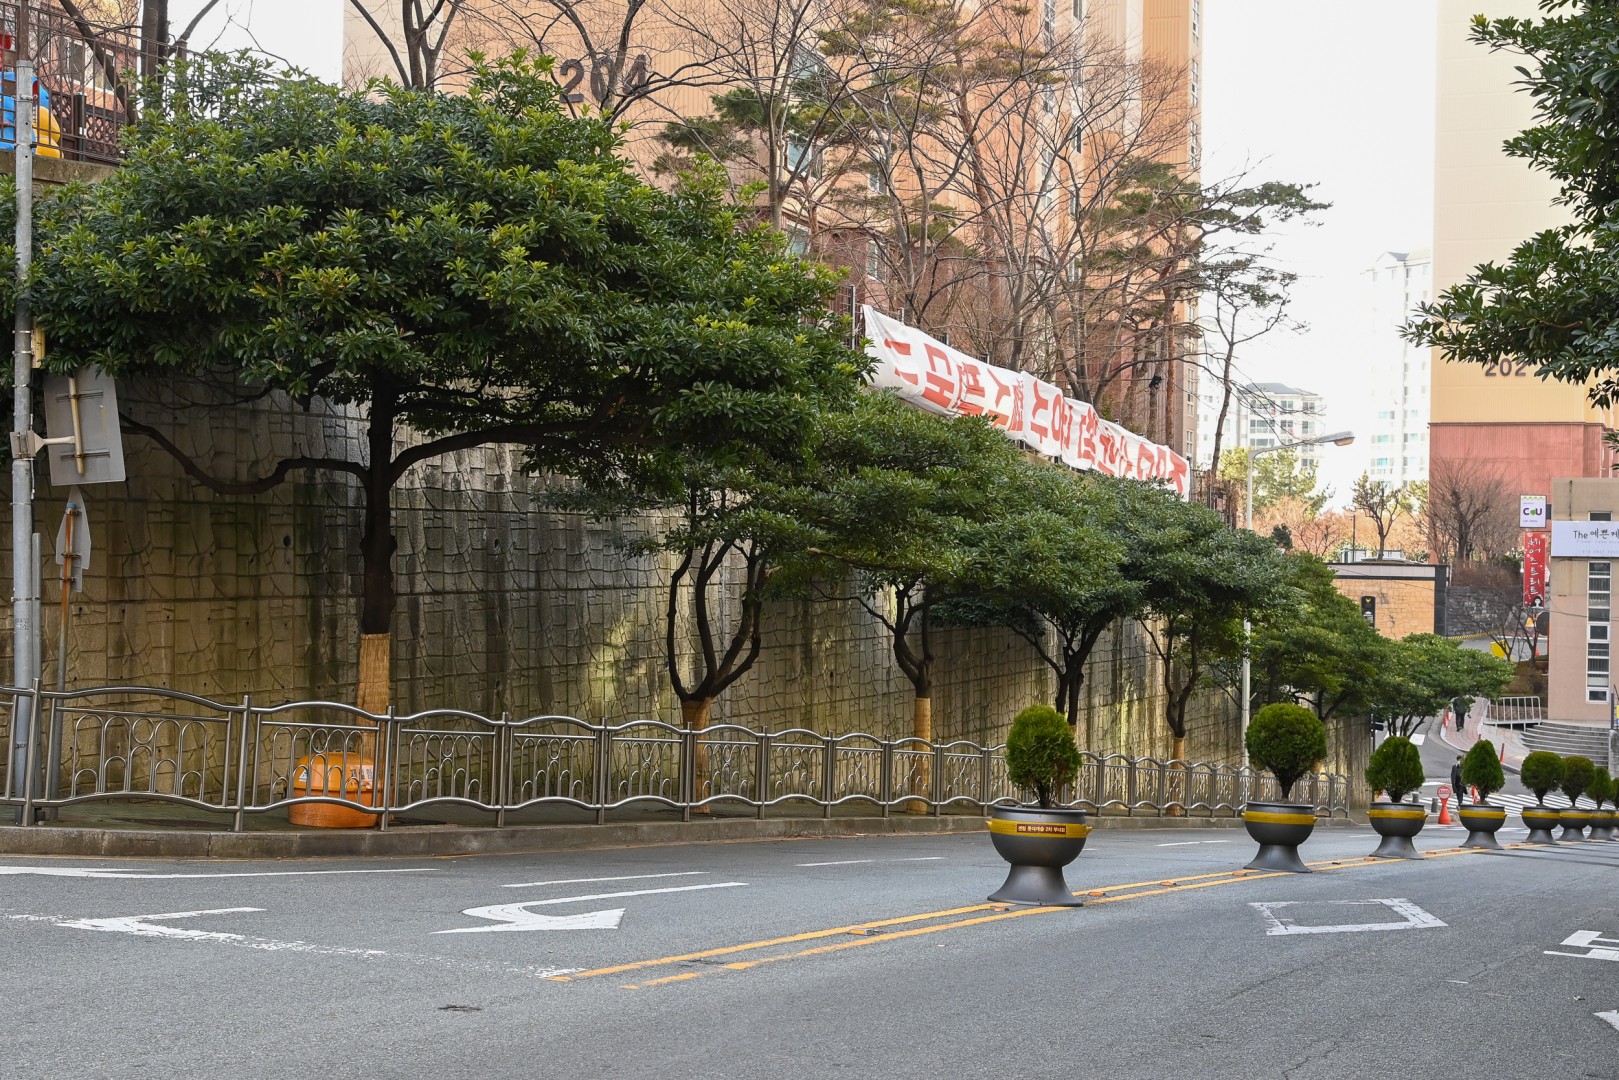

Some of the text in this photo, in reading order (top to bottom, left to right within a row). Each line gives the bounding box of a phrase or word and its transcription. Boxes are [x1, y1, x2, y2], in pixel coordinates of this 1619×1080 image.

[559, 54, 649, 103] 204
[1522, 507, 1543, 516] CU
[1573, 530, 1588, 539] The
